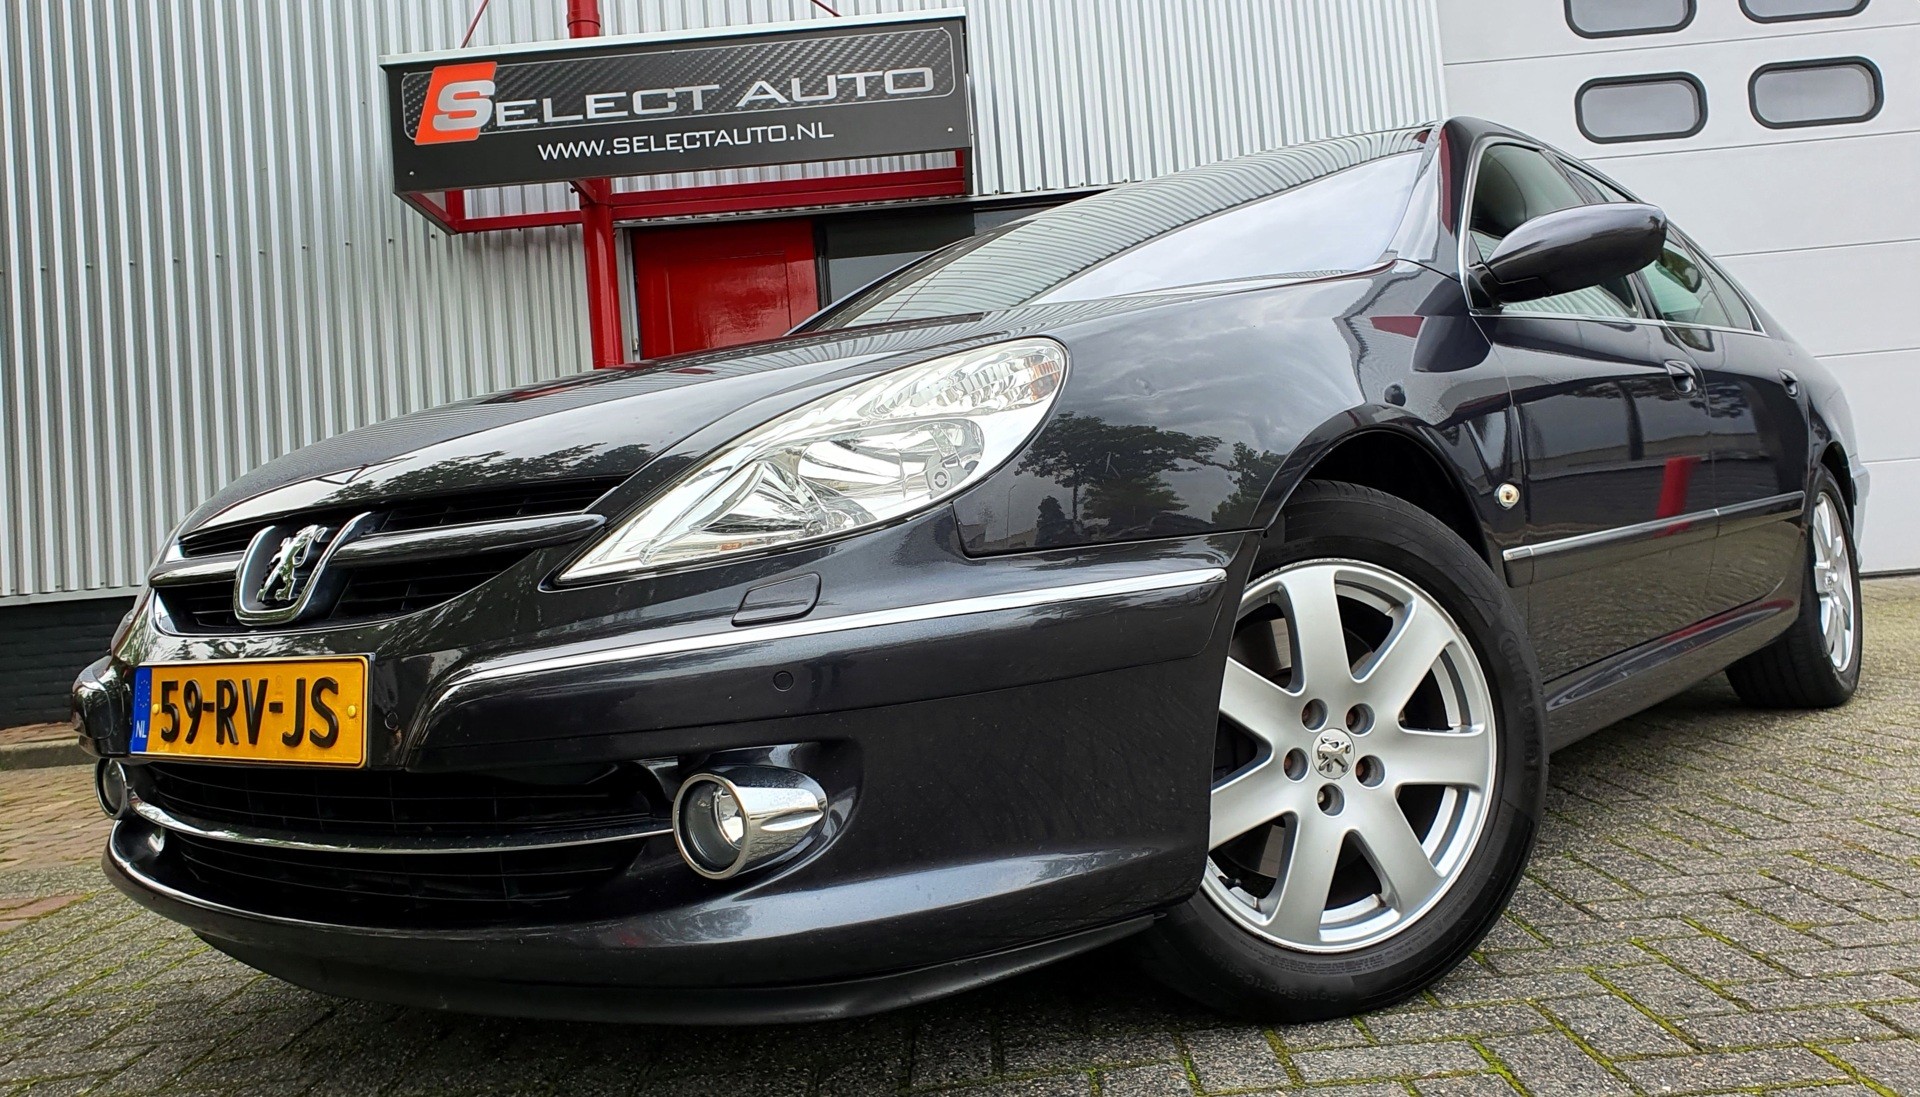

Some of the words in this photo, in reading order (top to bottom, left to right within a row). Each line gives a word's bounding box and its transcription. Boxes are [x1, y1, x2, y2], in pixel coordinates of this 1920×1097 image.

[432, 80, 720, 131] SELECT
[735, 67, 934, 108] AUTO
[537, 121, 834, 161] WWW.SELECTAUTO.NL
[135, 720, 147, 738] NL
[161, 677, 339, 748] 59-RV-JS
